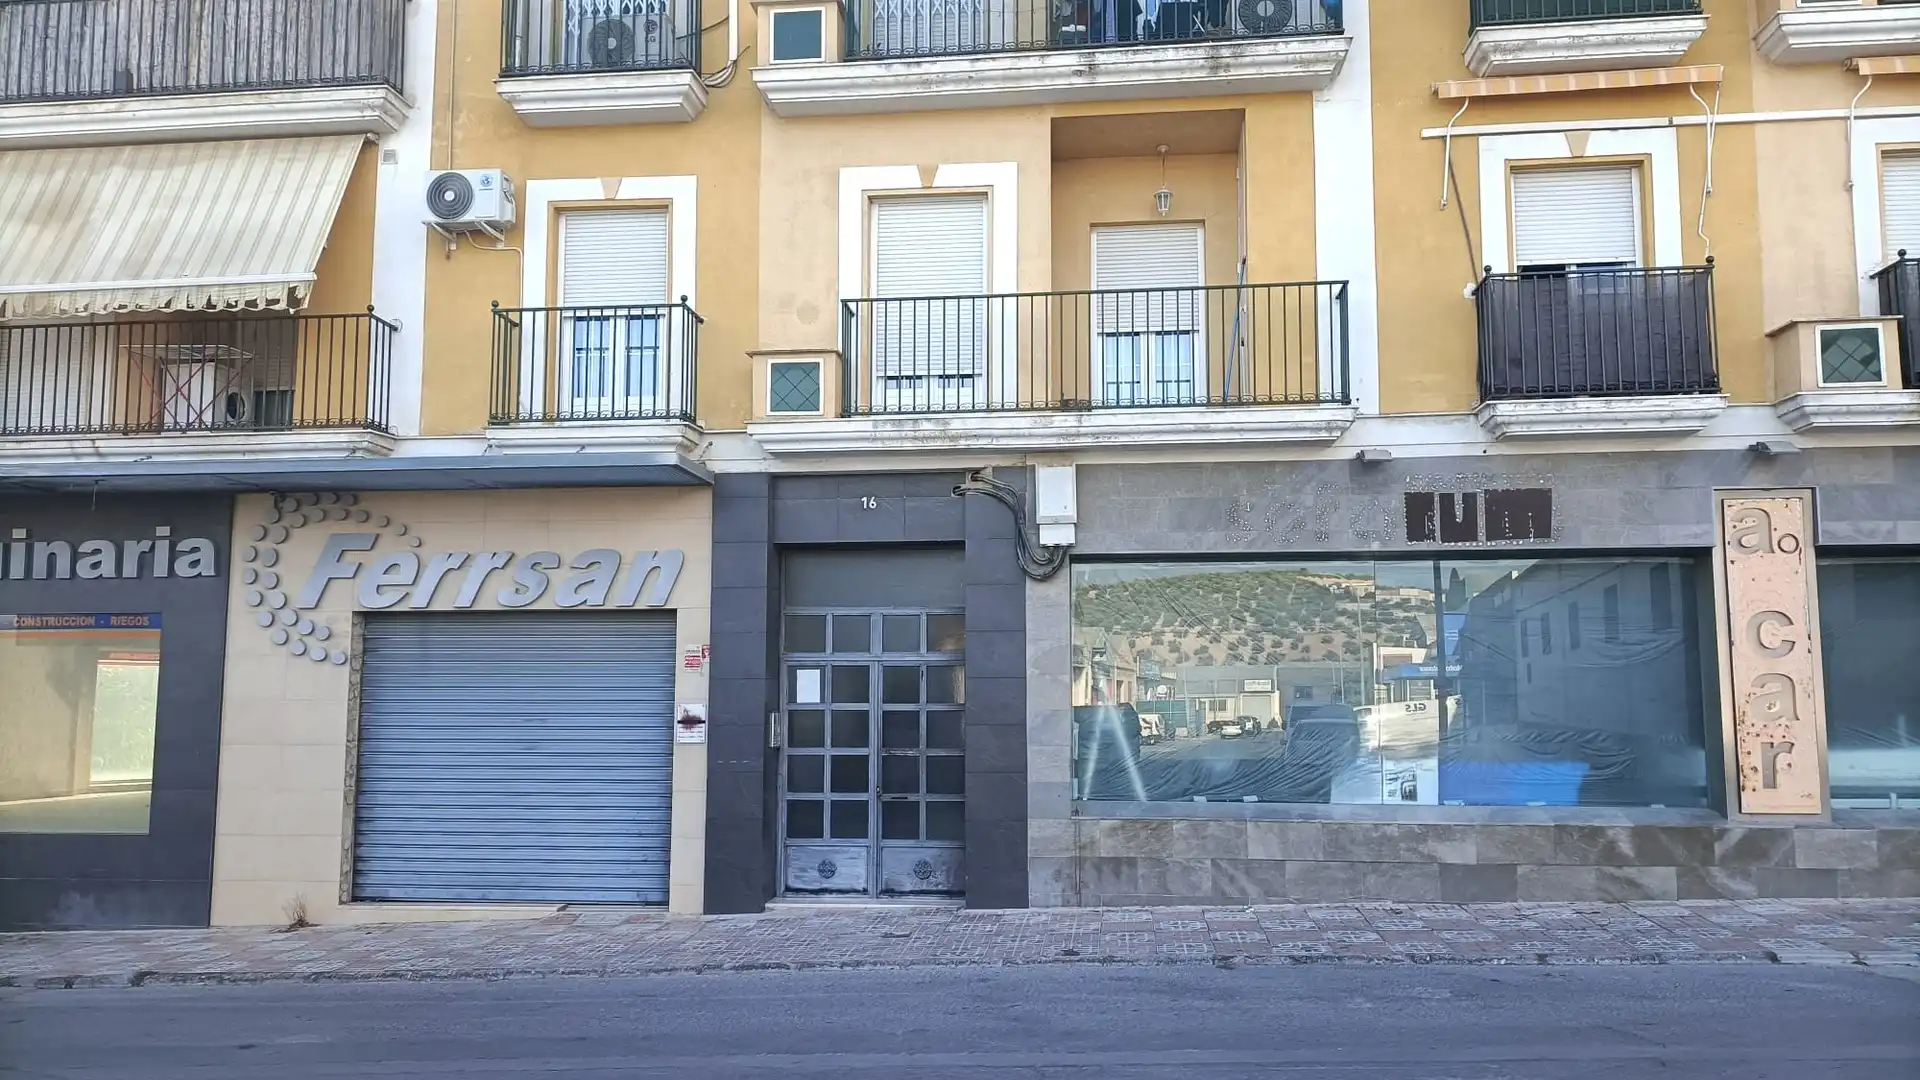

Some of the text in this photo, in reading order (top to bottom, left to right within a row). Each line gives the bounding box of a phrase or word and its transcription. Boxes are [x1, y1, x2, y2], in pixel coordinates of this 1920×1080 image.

[861, 496, 877, 509] 16
[0, 526, 217, 580] inaria
[298, 533, 685, 608] Ferrsan
[13, 616, 96, 627] CONSTRUCCION
[110, 615, 150, 626] RIEGOS
